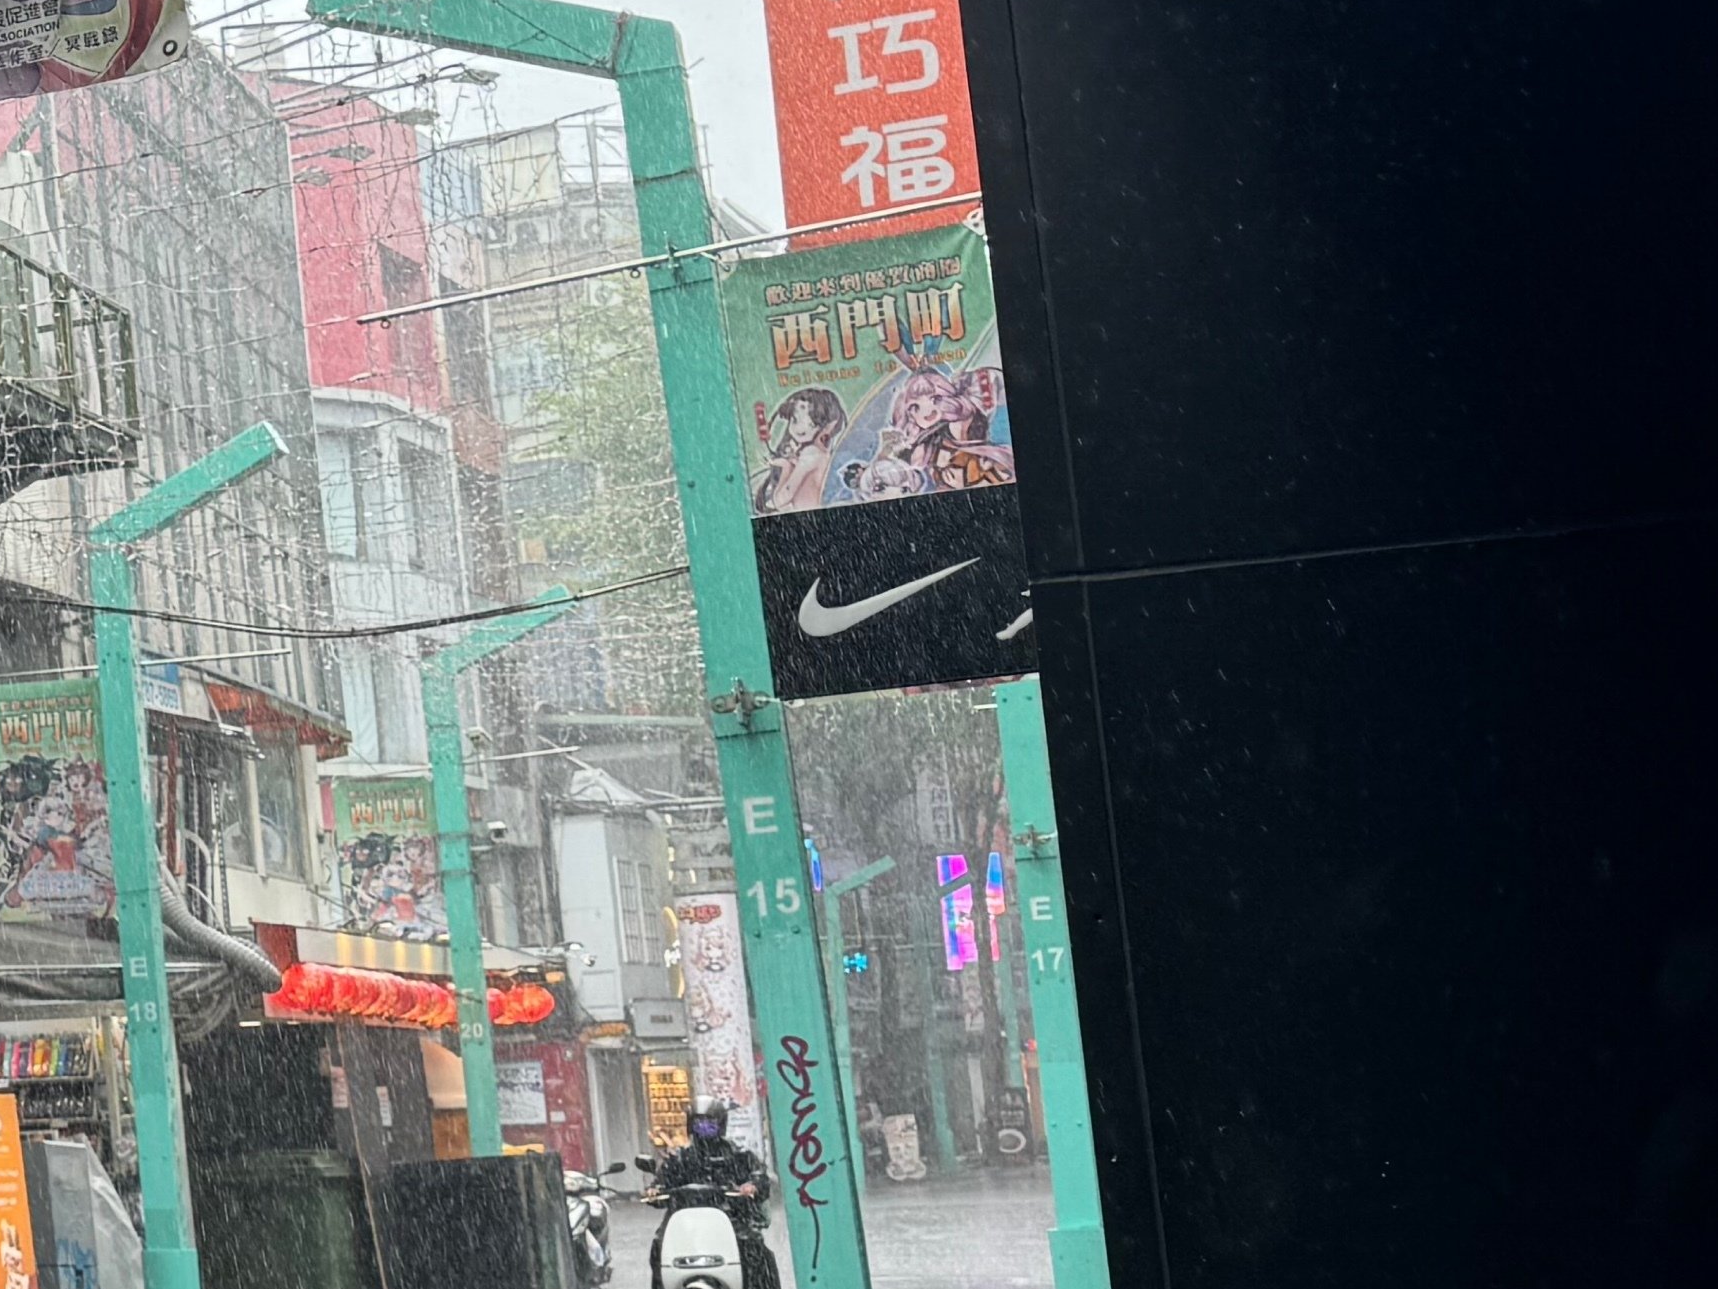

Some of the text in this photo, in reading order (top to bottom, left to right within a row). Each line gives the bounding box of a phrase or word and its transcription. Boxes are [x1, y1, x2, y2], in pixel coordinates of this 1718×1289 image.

[767, 282, 966, 371] 西門町
[741, 795, 778, 836] E
[746, 877, 800, 917] 15
[1029, 896, 1053, 920] E
[130, 957, 149, 977] E
[1031, 947, 1064, 973] 17
[129, 1000, 158, 1022] 18
[461, 1023, 483, 1038] 20
